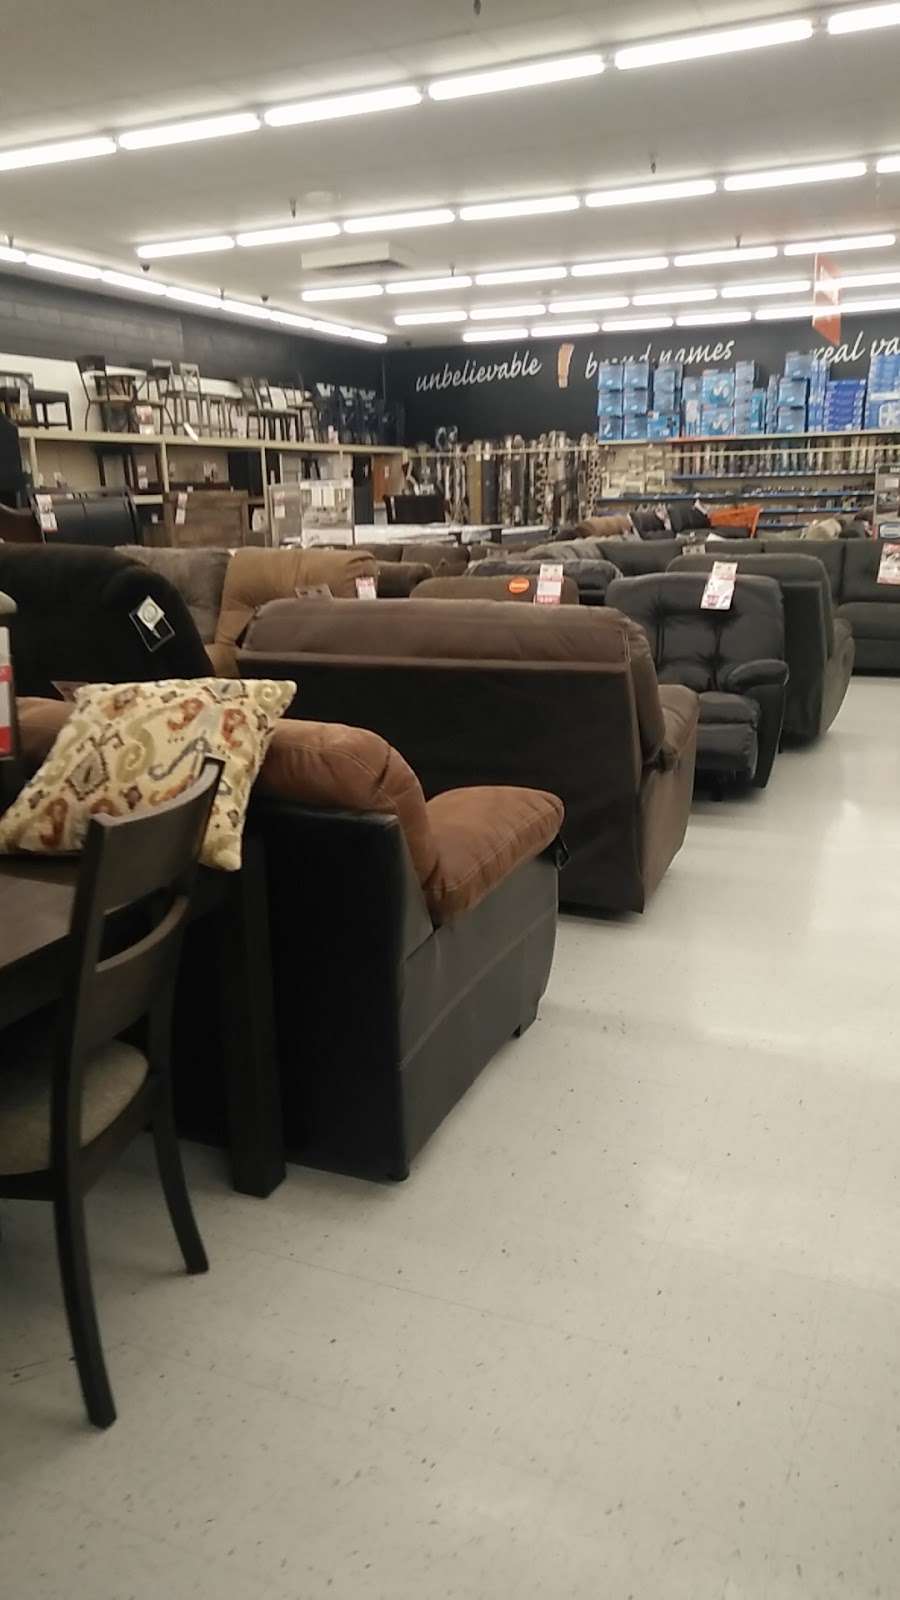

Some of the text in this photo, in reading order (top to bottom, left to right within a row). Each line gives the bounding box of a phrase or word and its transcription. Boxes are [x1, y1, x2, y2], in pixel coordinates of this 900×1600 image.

[416, 350, 542, 392] unbelievable
[659, 340, 735, 364] names
[813, 330, 866, 363] real
